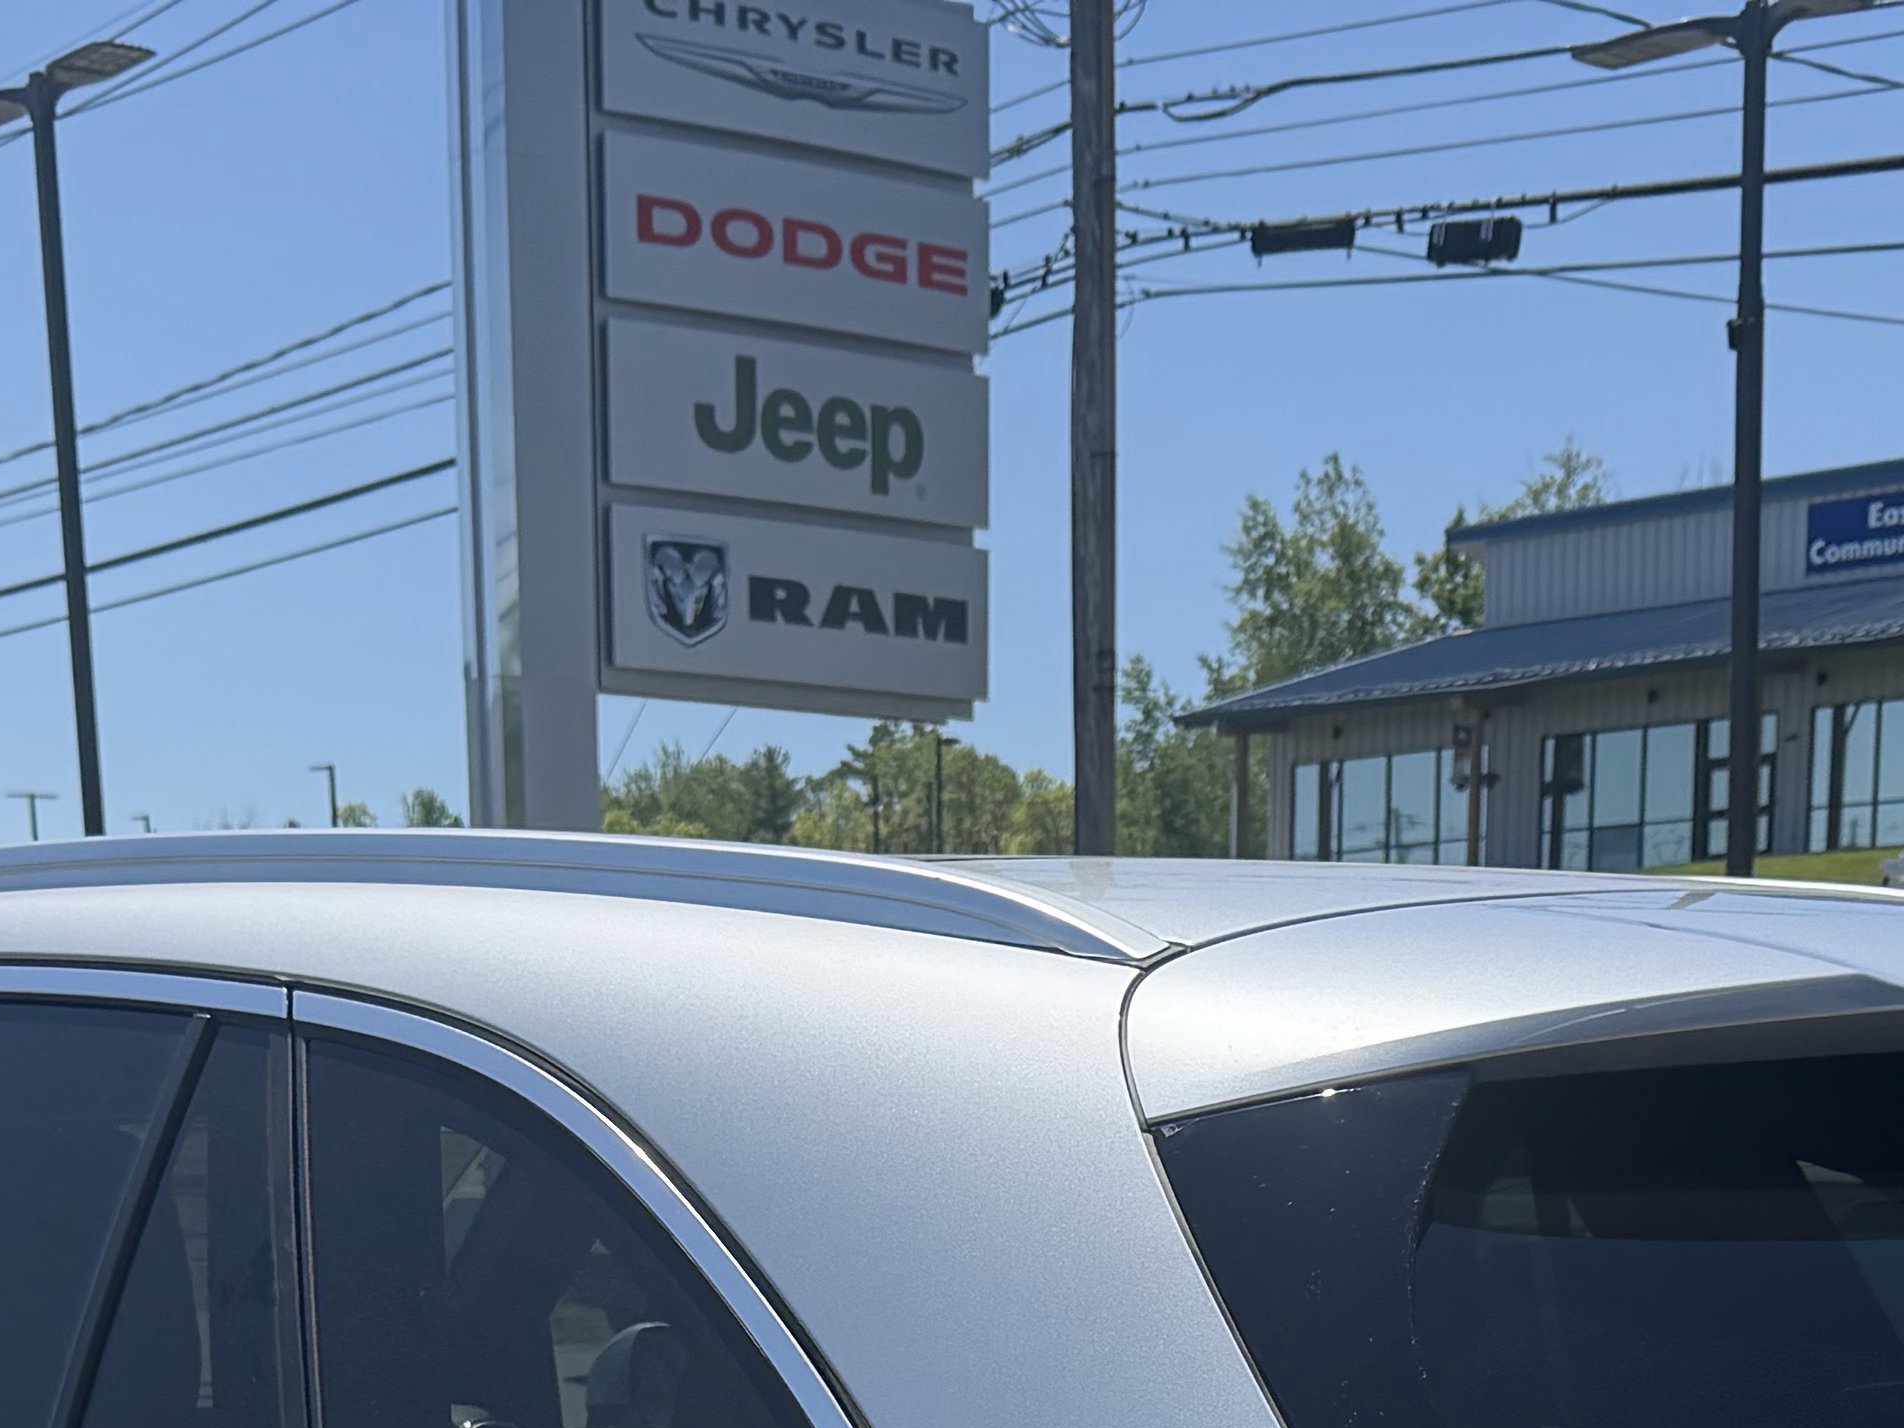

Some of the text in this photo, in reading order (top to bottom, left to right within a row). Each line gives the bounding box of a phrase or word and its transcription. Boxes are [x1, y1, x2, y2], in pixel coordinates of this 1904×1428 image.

[644, 0, 960, 77] CHRYSLER
[636, 195, 968, 297] DODGE
[694, 355, 924, 495] Jeep
[747, 574, 969, 645] RAM
